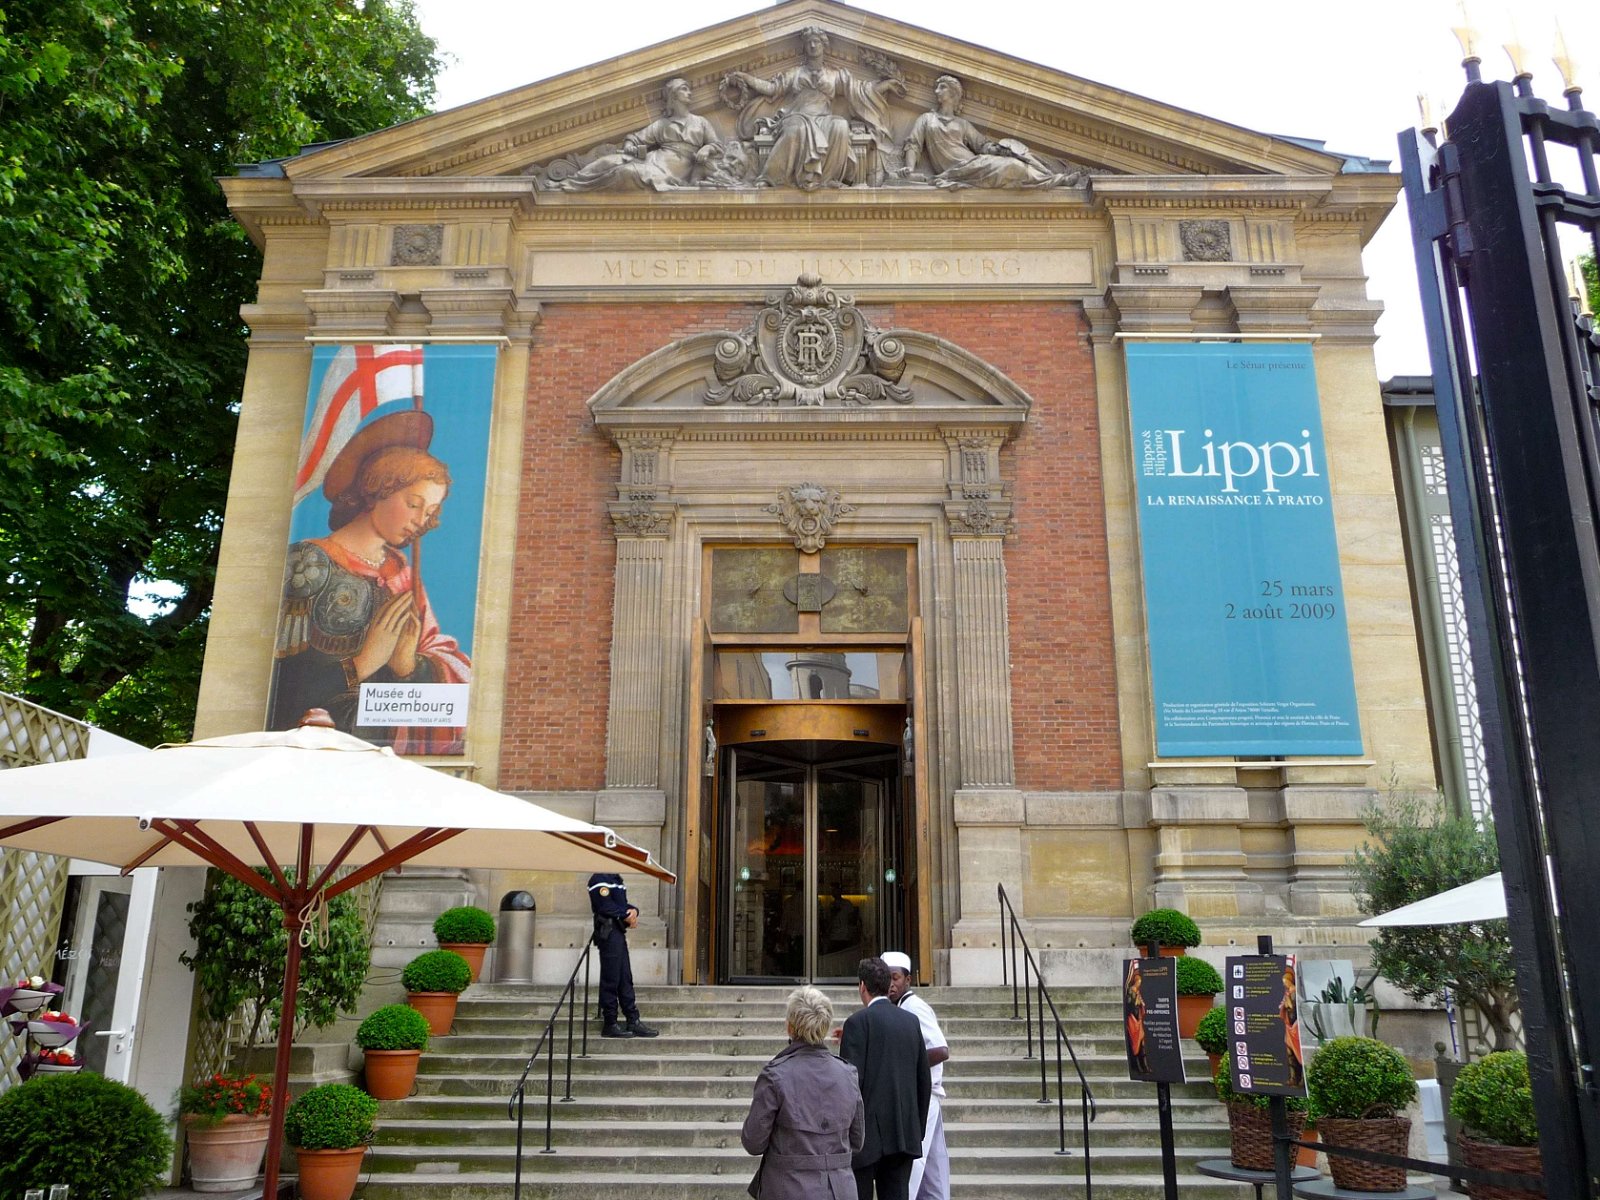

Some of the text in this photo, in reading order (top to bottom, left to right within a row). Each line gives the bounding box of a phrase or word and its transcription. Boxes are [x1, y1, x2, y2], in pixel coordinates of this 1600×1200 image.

[602, 256, 1020, 278] MUSÉE DU LUXEMBOURG
[1226, 360, 1306, 372] Le Sénat présente
[1141, 430, 1155, 475] Filippo &
[1154, 429, 1167, 475] Filippino
[1164, 429, 1320, 493] Lippi
[1147, 493, 1323, 505] LA RENAISSANCE À PRATO
[1260, 580, 1334, 597] 25 mars
[1224, 603, 1335, 620] 2 août 2009
[366, 688, 422, 698] Musée du
[364, 700, 454, 716] Luxembourg
